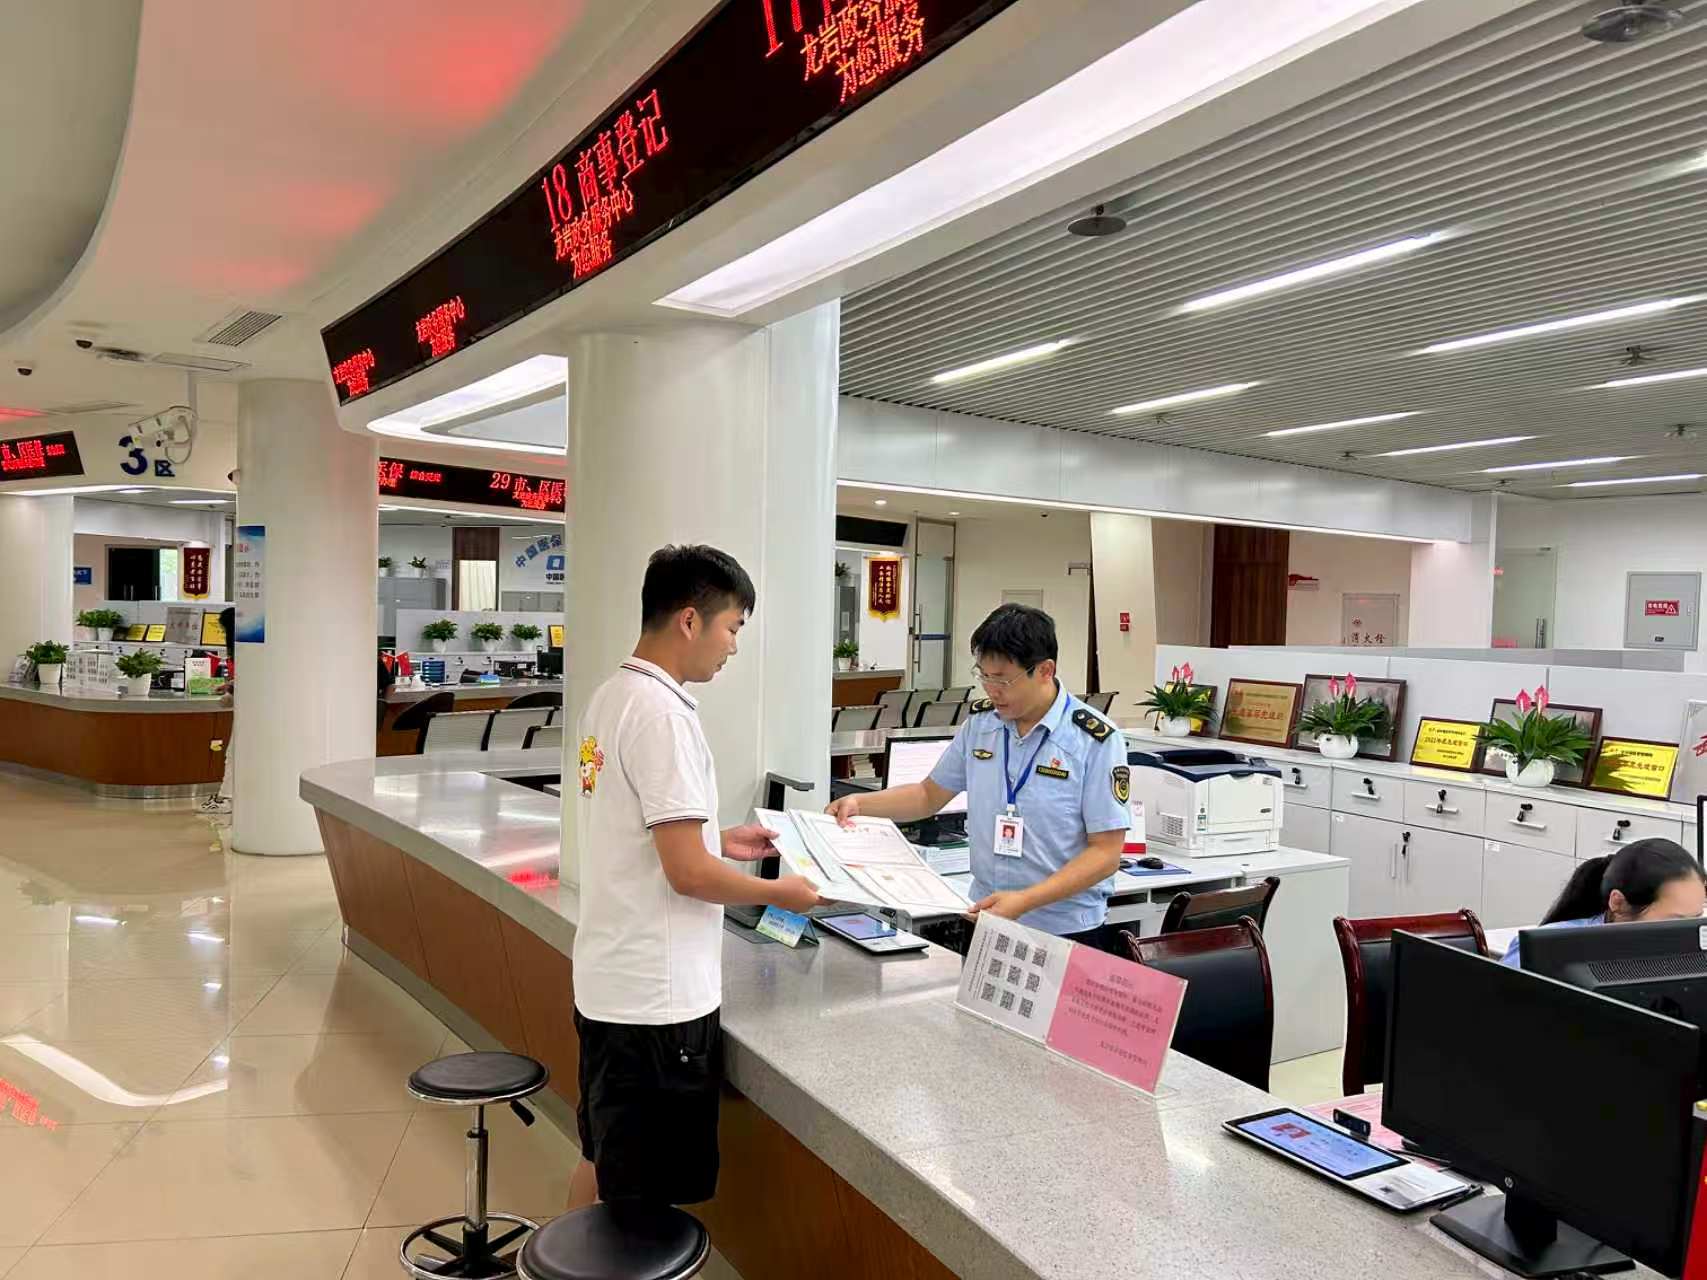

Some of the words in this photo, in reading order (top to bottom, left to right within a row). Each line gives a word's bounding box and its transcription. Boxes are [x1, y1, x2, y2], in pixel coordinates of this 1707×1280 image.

[541, 162, 573, 233] 18
[574, 88, 669, 211] 商事登记
[489, 472, 511, 489] 29
